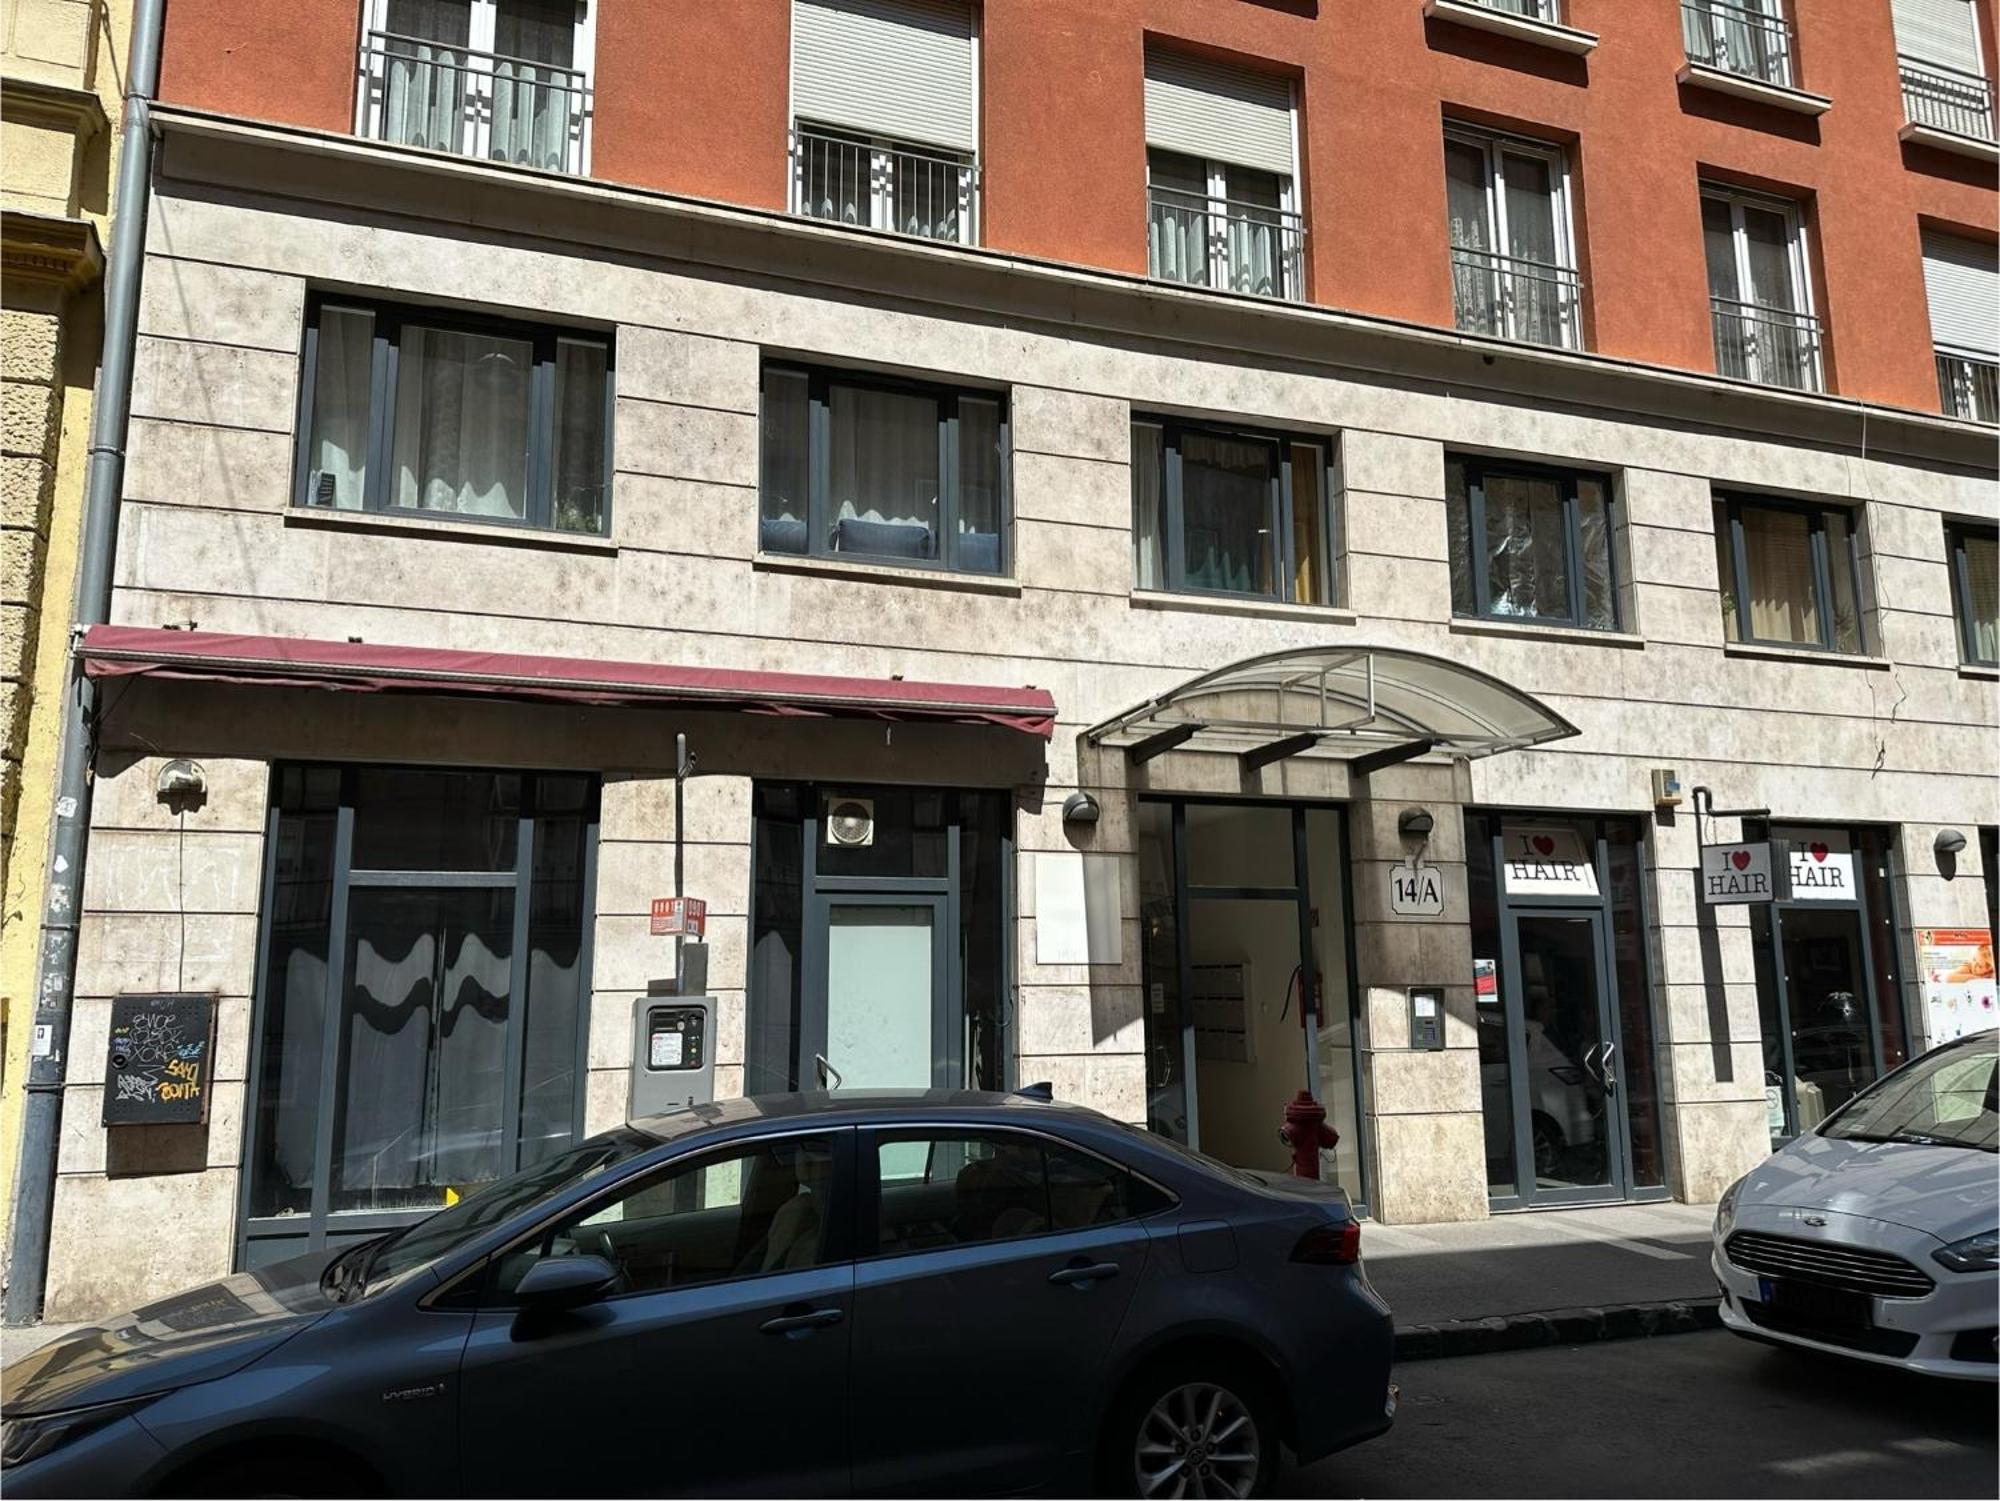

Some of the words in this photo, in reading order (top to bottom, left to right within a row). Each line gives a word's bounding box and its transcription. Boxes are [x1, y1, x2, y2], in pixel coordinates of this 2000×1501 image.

[1518, 834, 1534, 855] I
[1797, 842, 1809, 862] I
[1507, 859, 1582, 881] HAIR
[1721, 851, 1732, 871] I
[1707, 872, 1770, 896] HAIR
[1789, 865, 1845, 888] HAIR
[1394, 876, 1439, 906] 14/A
